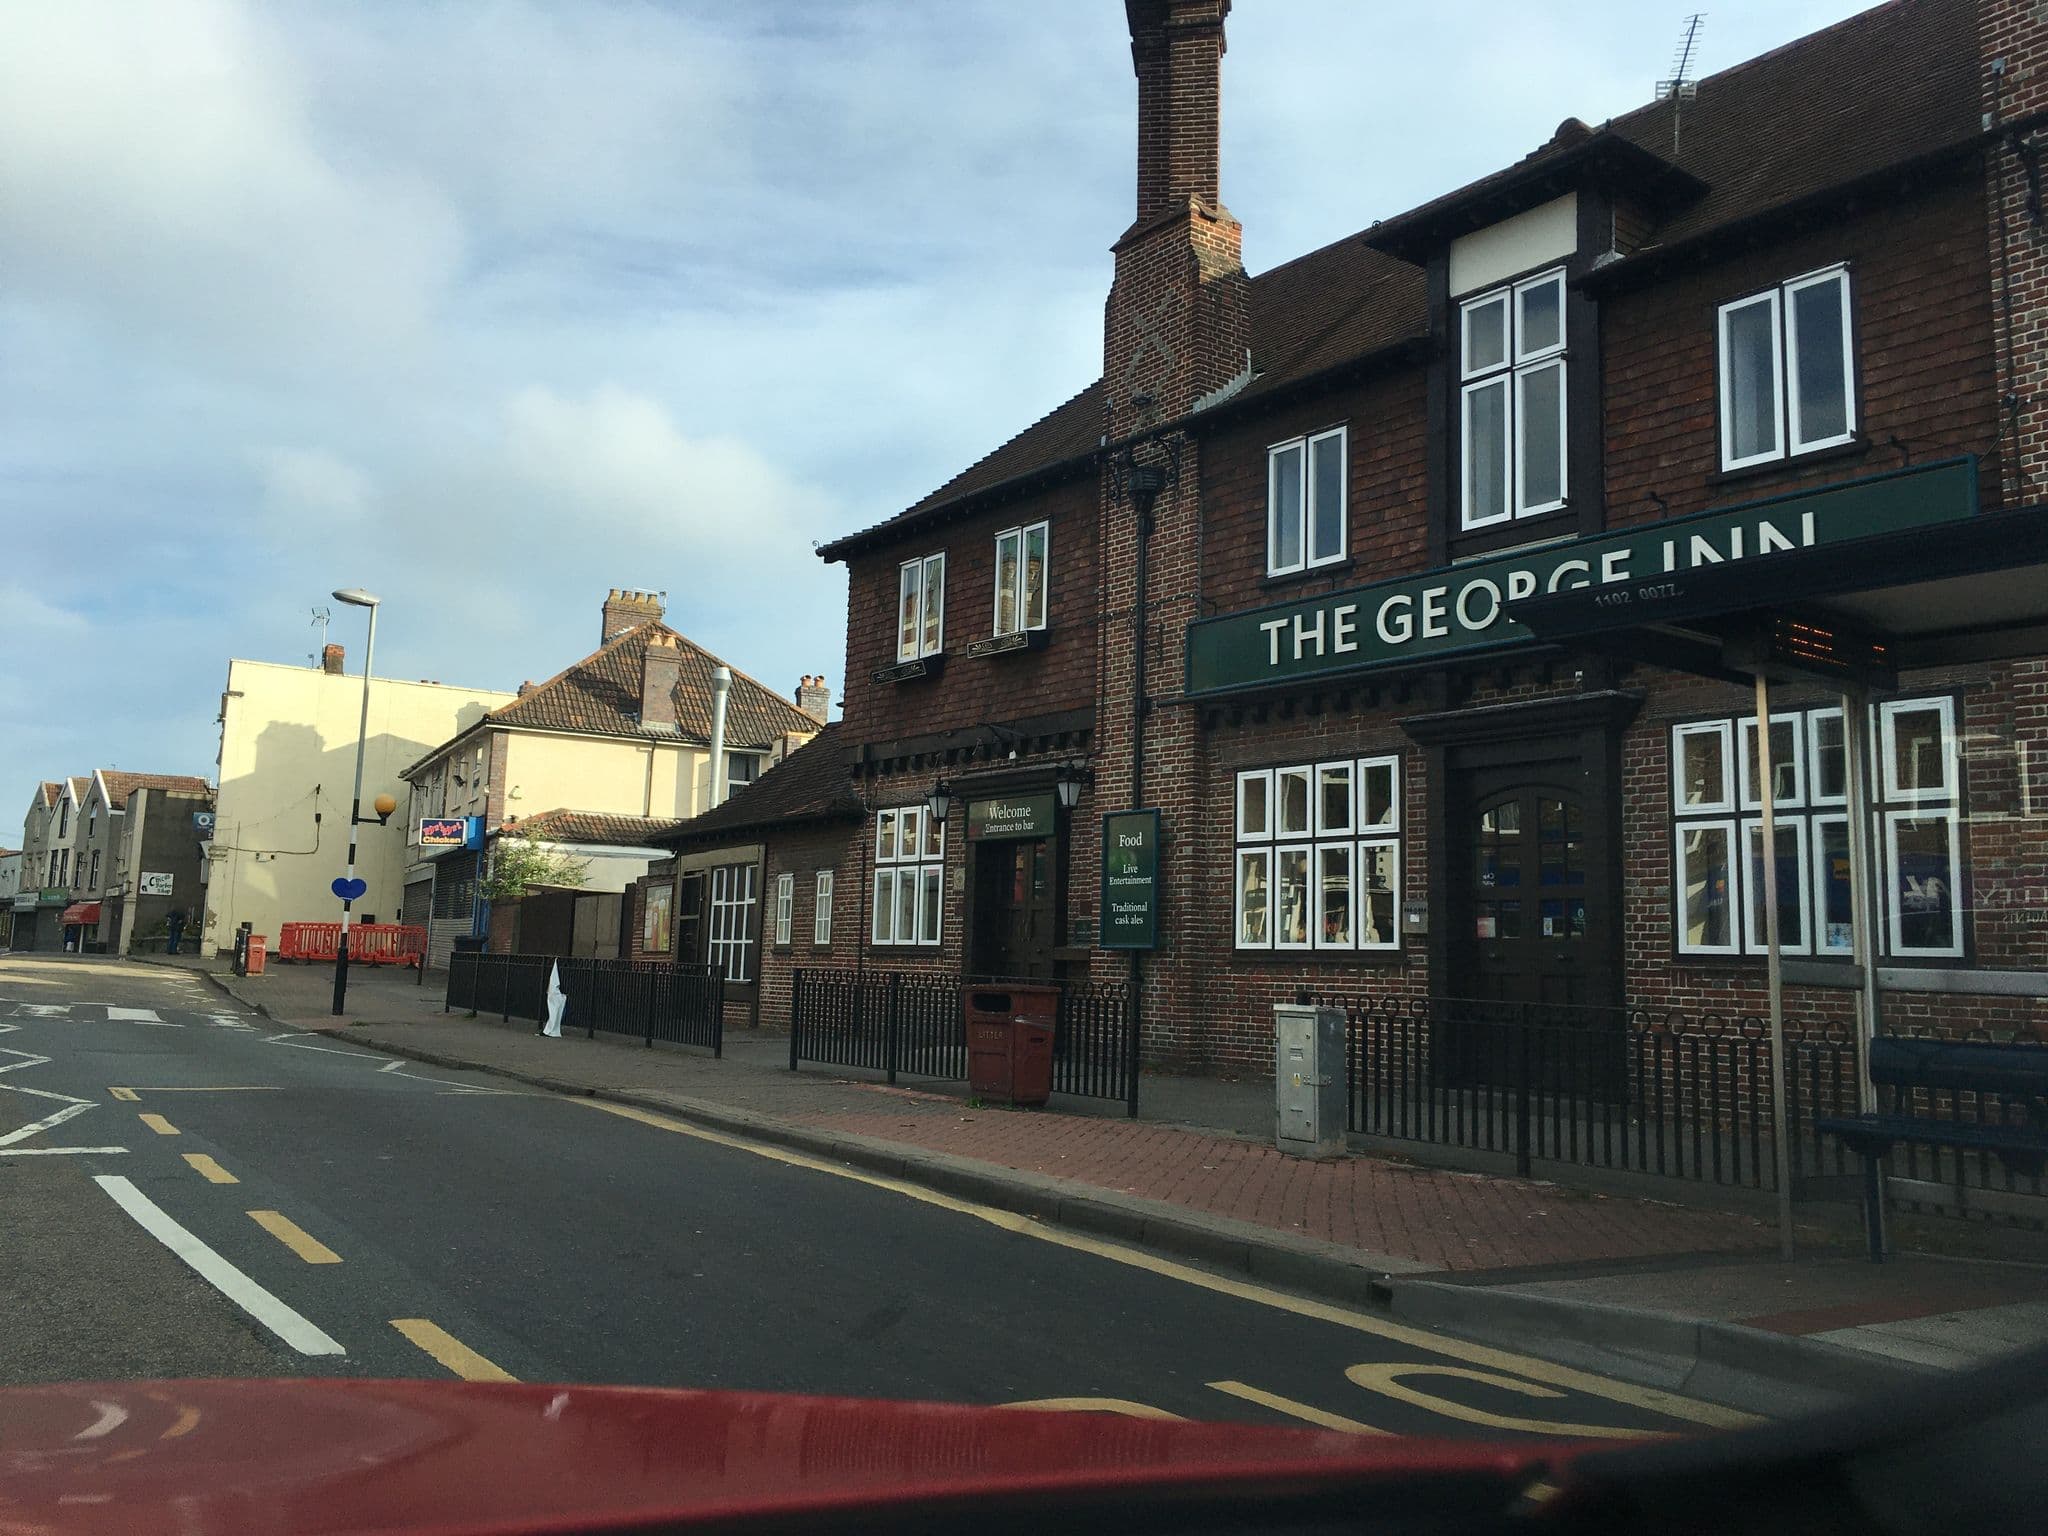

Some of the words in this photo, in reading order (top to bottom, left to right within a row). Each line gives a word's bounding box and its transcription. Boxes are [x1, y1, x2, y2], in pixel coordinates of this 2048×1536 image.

[1260, 604, 1358, 665] THE
[1376, 549, 1632, 644] GEORGE
[1663, 511, 1816, 572] INN
[1595, 591, 1632, 607] 1102
[989, 804, 1031, 819] Welcome
[985, 823, 1014, 833] Entrance
[1015, 822, 1022, 831] to
[1022, 819, 1034, 830] bar
[1119, 832, 1142, 847] Food
[1123, 863, 1138, 874] Live
[1109, 875, 1152, 885] Entertainment
[1112, 901, 1148, 912] Traditional
[1115, 914, 1129, 925] cask
[1130, 914, 1144, 925] ales
